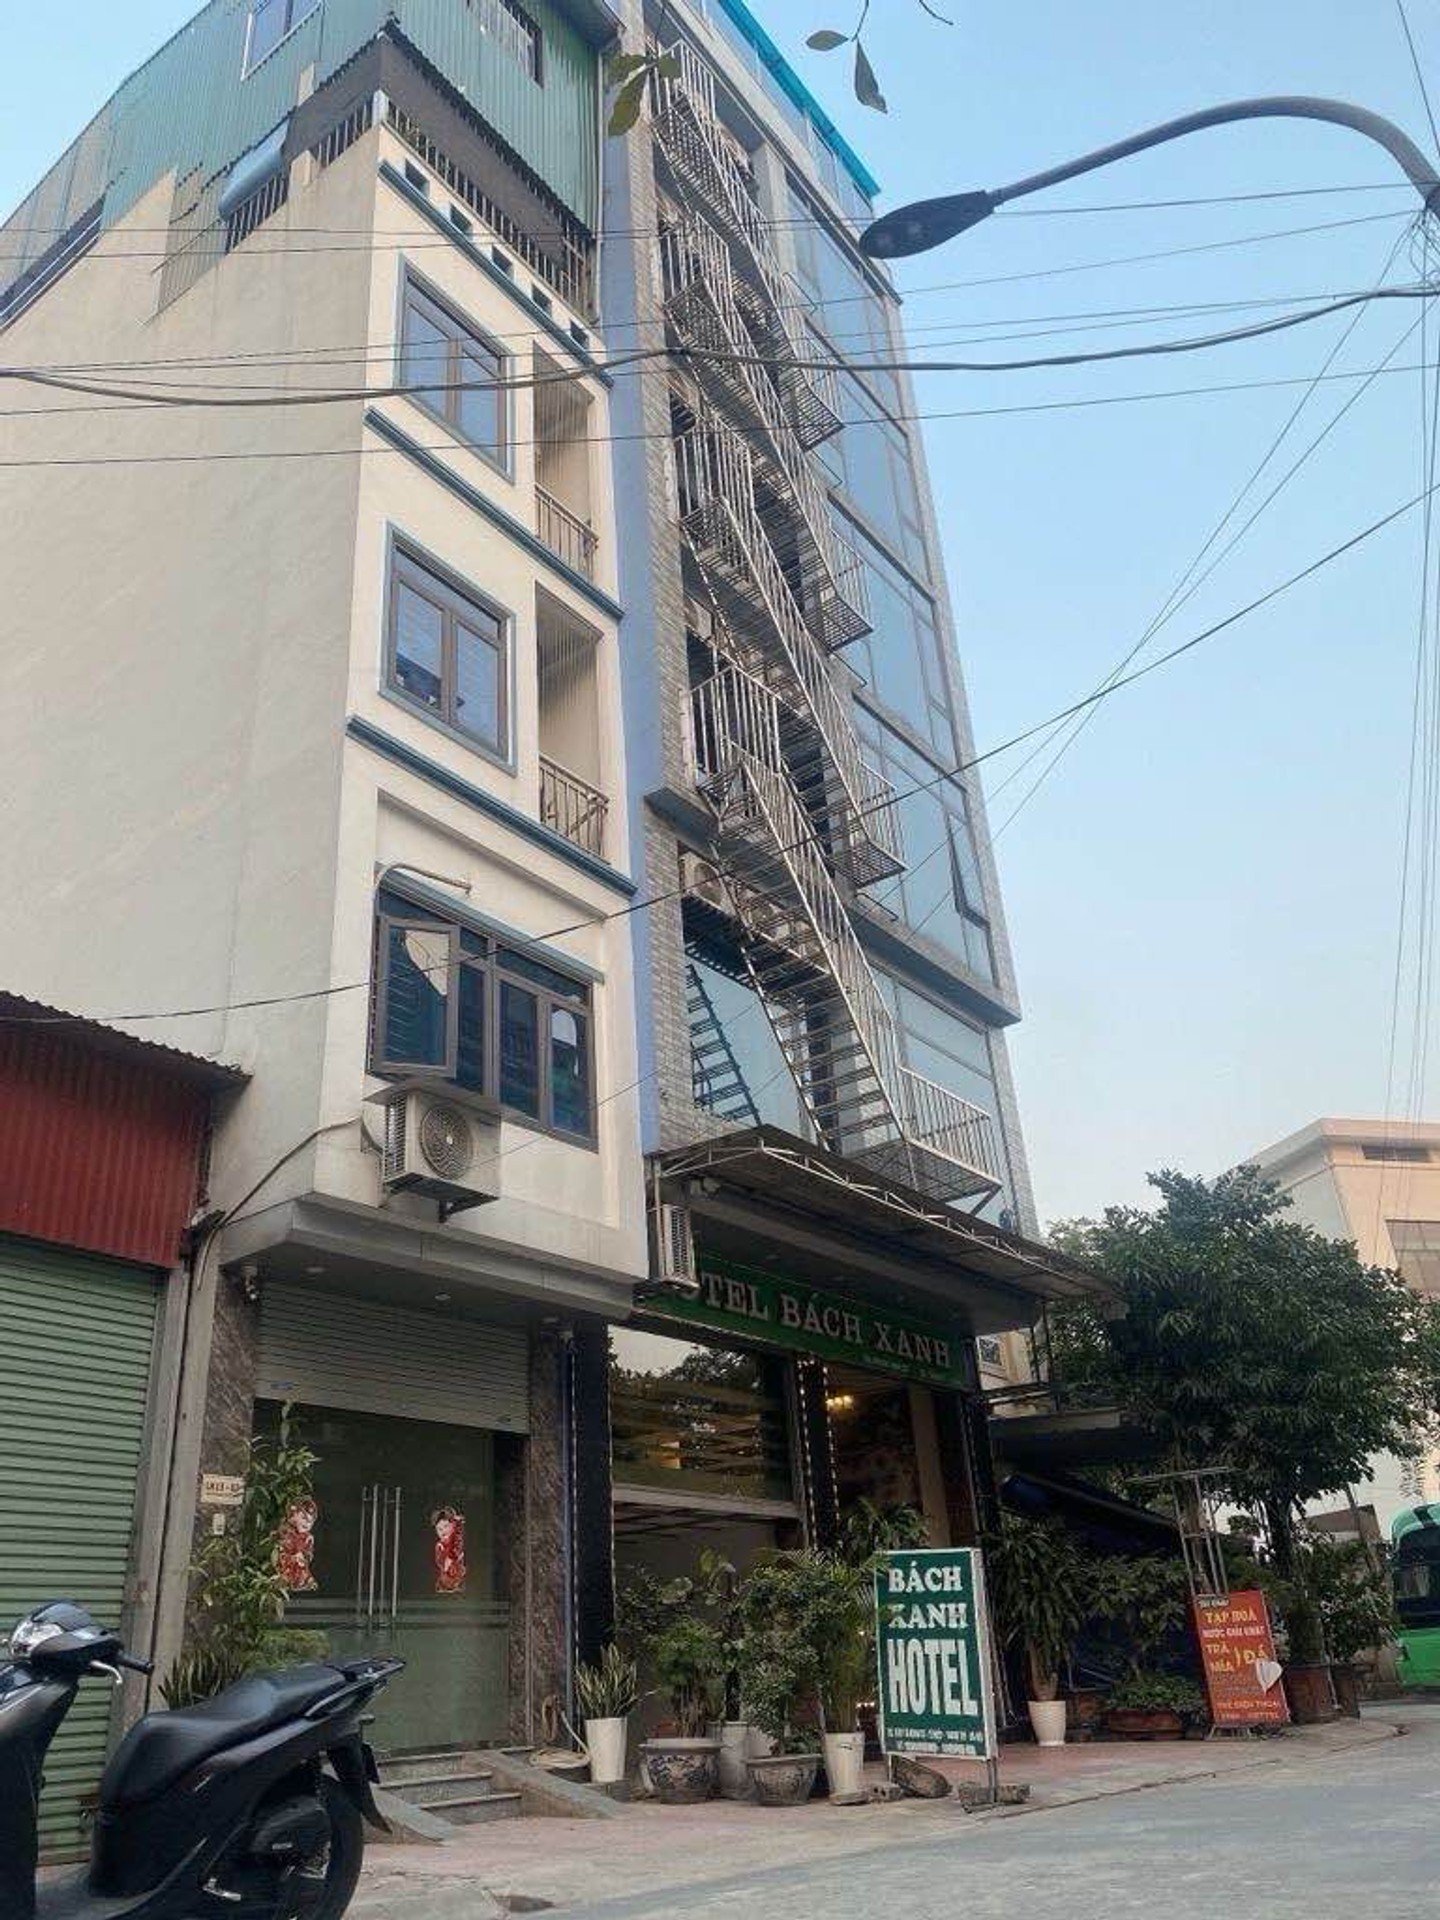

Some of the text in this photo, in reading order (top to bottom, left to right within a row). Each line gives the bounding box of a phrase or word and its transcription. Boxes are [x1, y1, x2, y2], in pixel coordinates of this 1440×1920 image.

[780, 1292, 863, 1345] BÁCH
[874, 1321, 951, 1368] XANH
[888, 1560, 963, 1593] BÁCH
[888, 1603, 969, 1629] XANH
[887, 1638, 979, 1716] HOTEL
